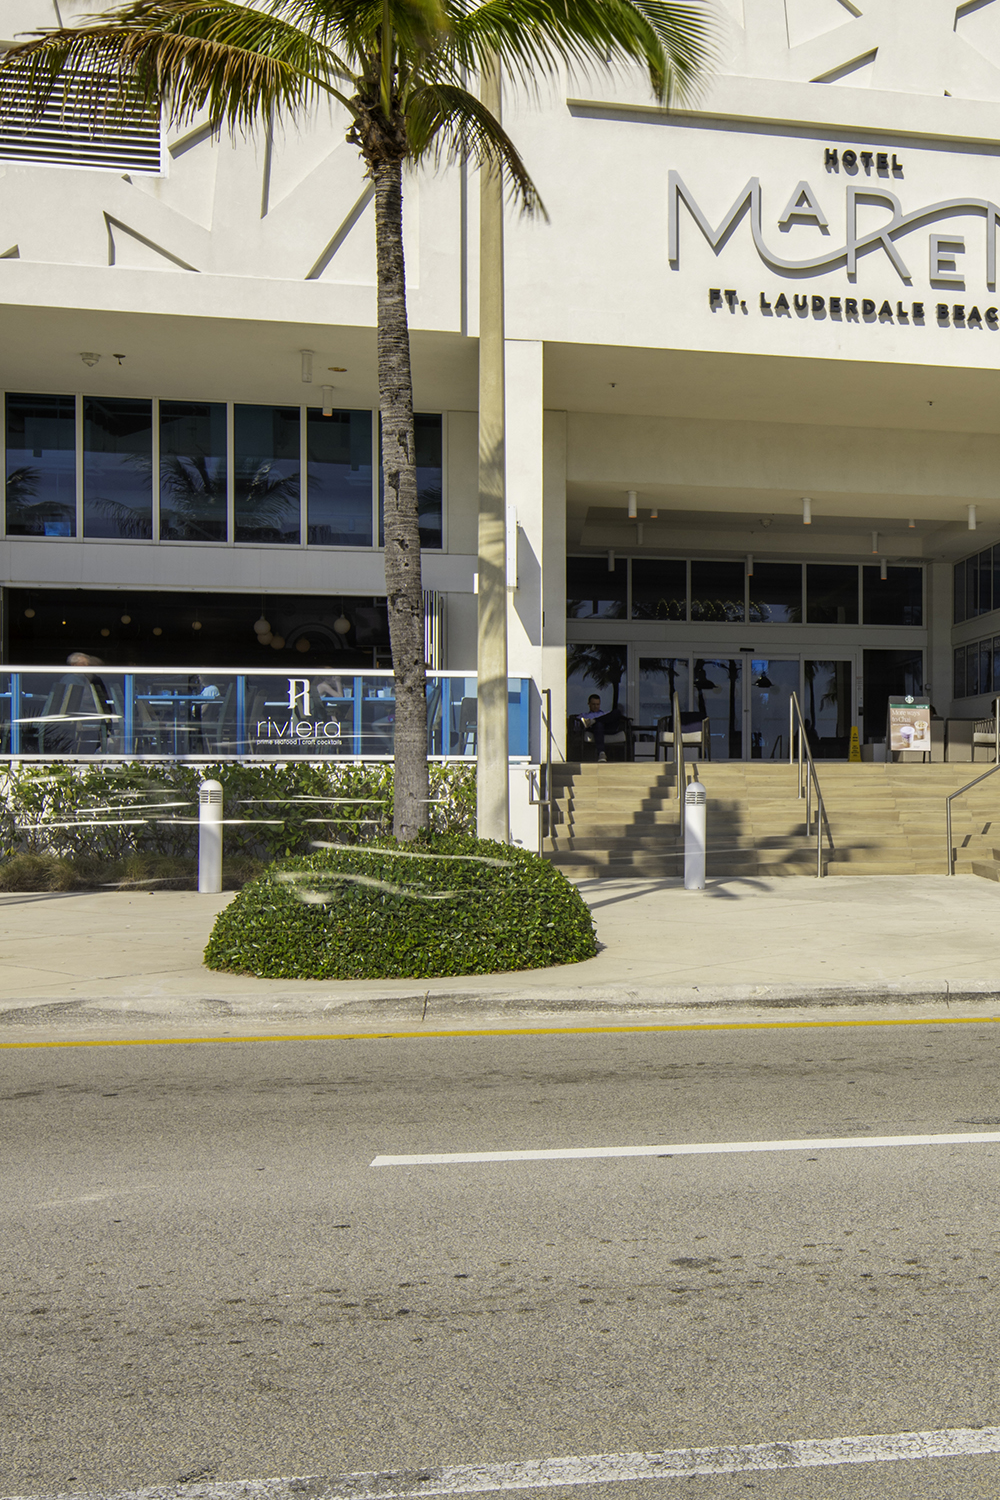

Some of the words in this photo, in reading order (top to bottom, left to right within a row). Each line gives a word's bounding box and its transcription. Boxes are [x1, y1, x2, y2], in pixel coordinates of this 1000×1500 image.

[825, 148, 903, 171] HOTEL
[709, 288, 746, 307] FT.
[760, 292, 924, 318] LAUDERDALE
[906, 710, 921, 718] ways
[256, 716, 342, 738] riviera
